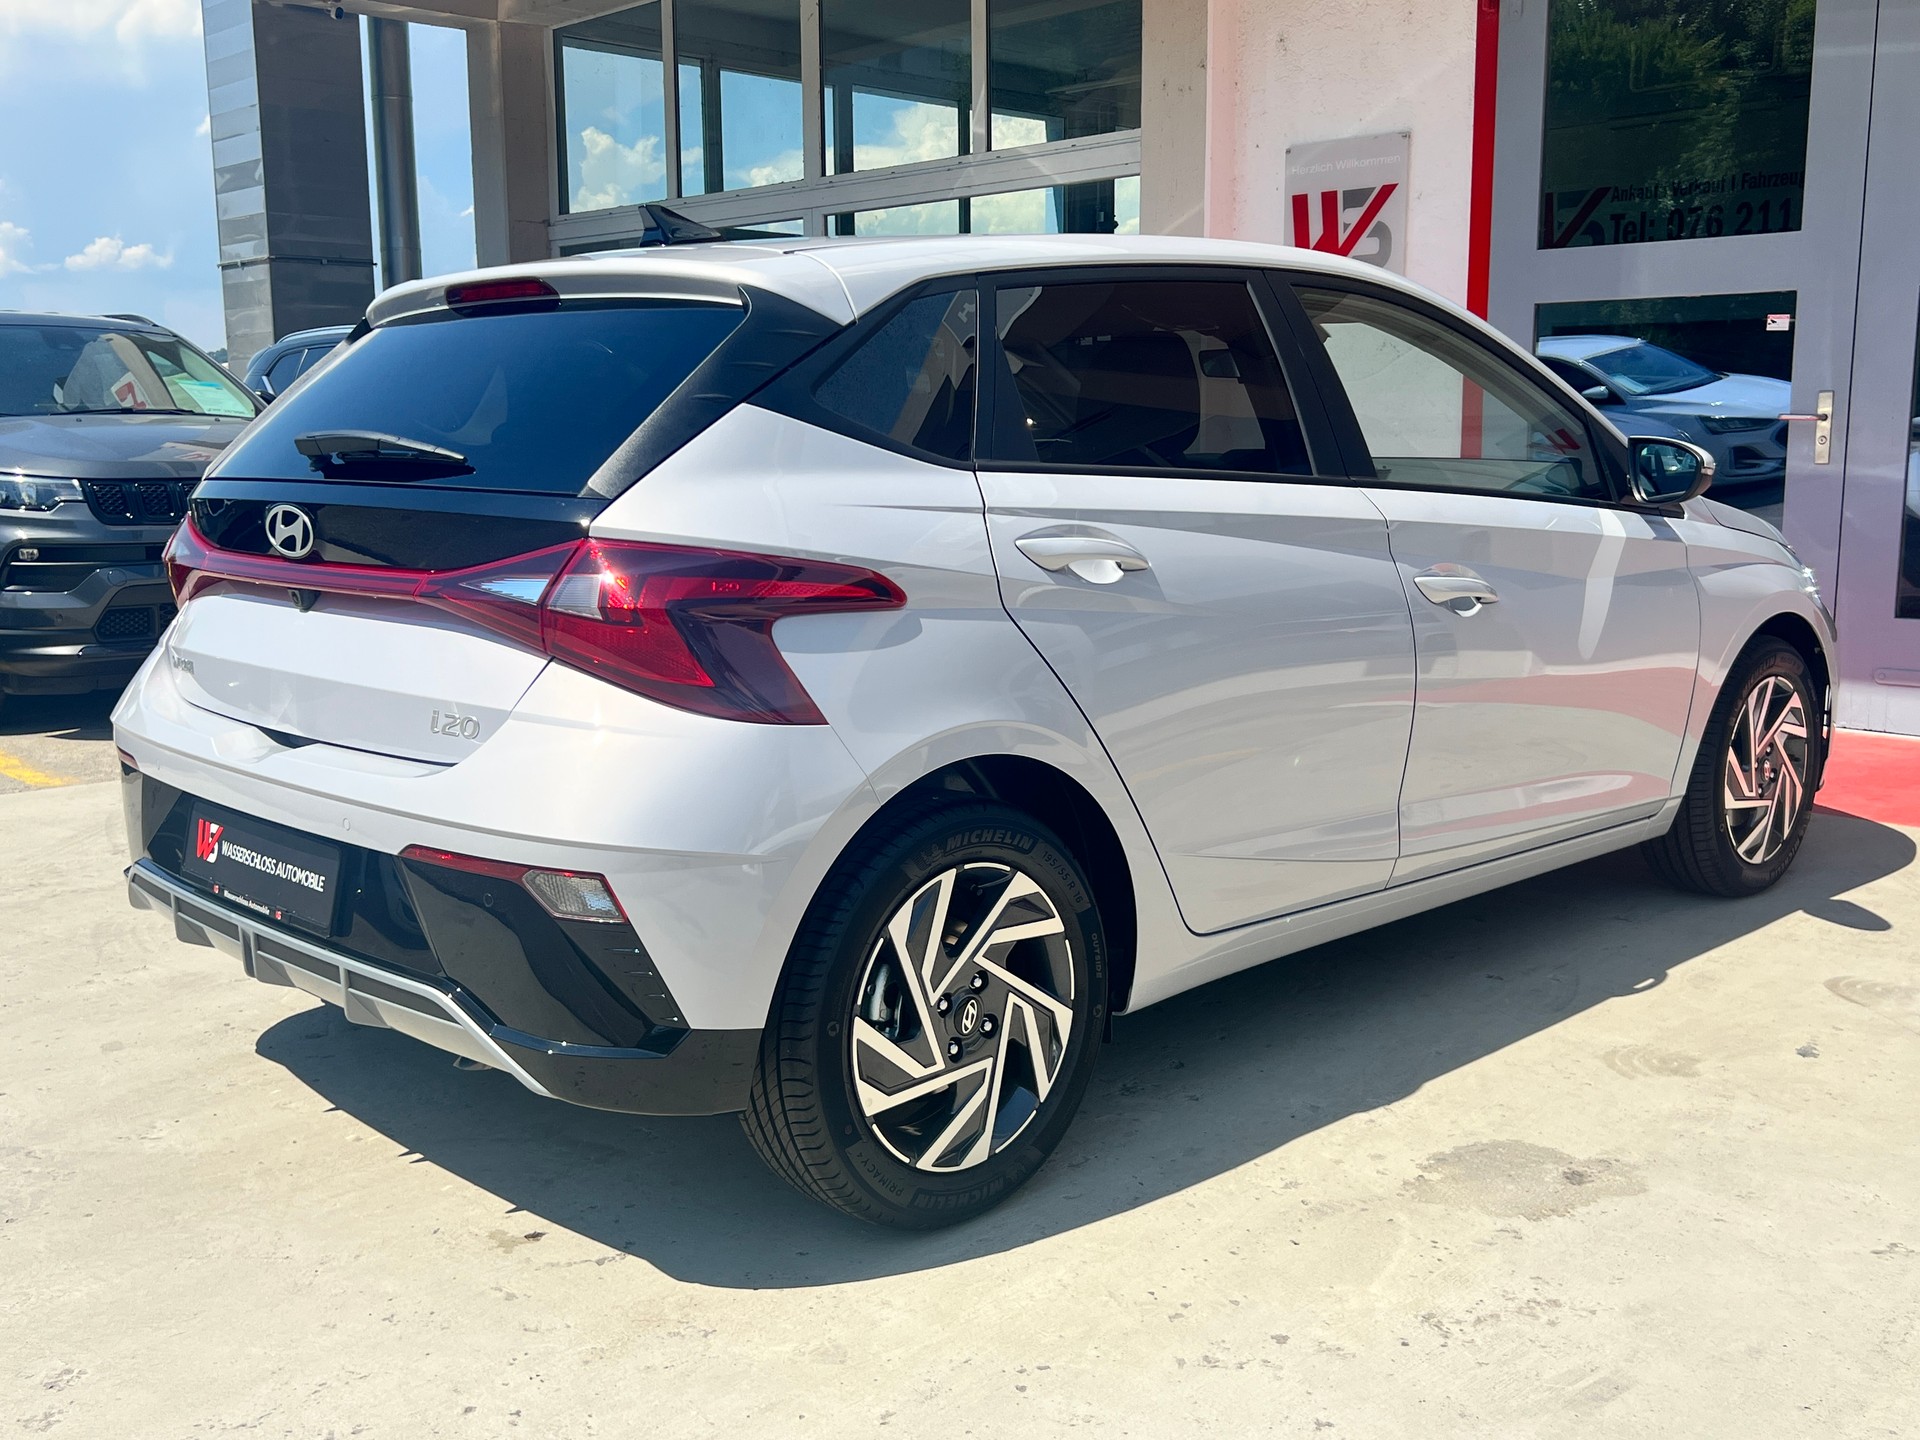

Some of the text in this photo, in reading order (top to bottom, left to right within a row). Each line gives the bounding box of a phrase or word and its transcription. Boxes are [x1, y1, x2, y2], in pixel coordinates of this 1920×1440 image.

[1291, 154, 1401, 176] Herzlich Willkommen
[1610, 184, 1660, 203] Ankauf
[1671, 177, 1727, 198] Verkauf
[1609, 197, 1793, 244] Tel: 076 211
[430, 709, 481, 740] i20
[945, 828, 1033, 852] MICHELIN
[221, 840, 326, 893] WASSERSCHLOSS AUTOMOBILE
[1042, 851, 1071, 881] 195/55
[1091, 932, 1102, 978] OUTSIDE
[860, 1156, 905, 1197] PRIMACY
